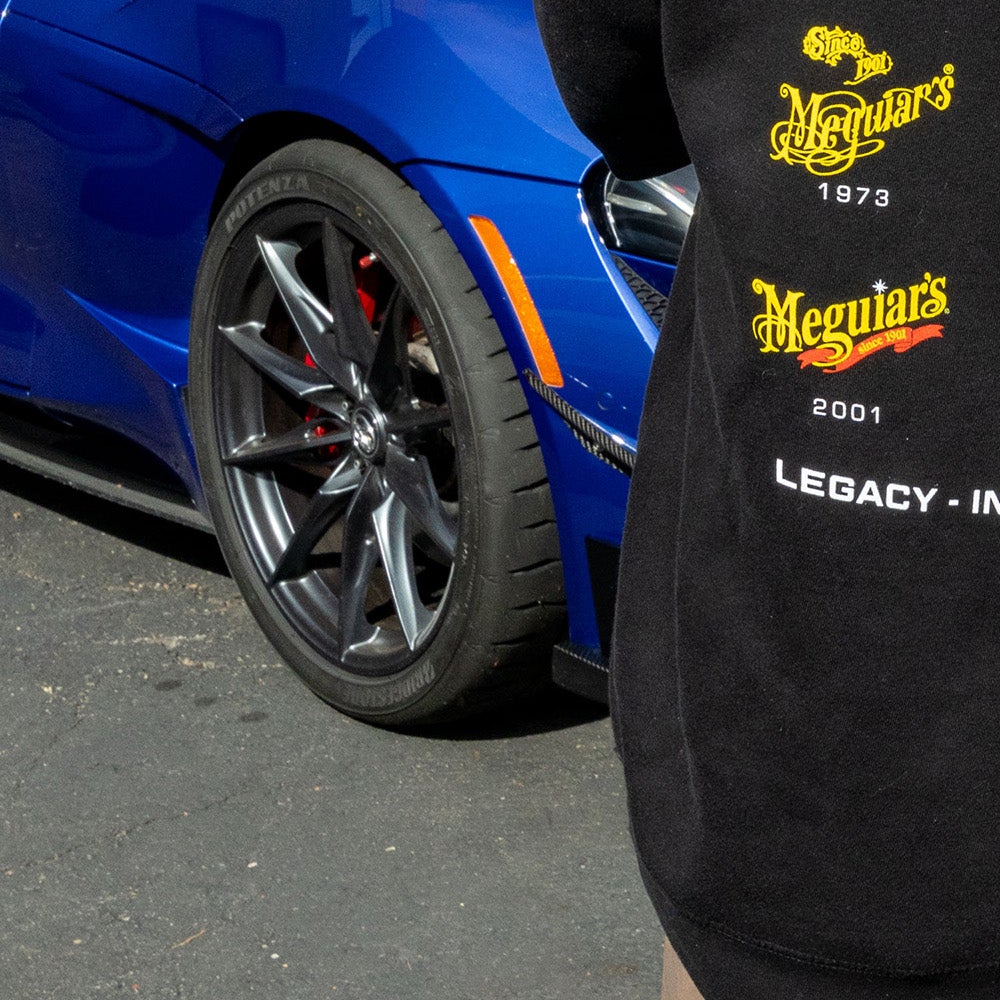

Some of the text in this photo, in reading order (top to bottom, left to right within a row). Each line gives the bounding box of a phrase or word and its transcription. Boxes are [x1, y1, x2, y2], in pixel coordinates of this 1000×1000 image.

[770, 75, 955, 176] Meguiar's
[818, 182, 889, 207] 1973
[751, 271, 947, 367] Meguiar's
[812, 397, 880, 424] 2001
[775, 458, 939, 513] LEGACY
